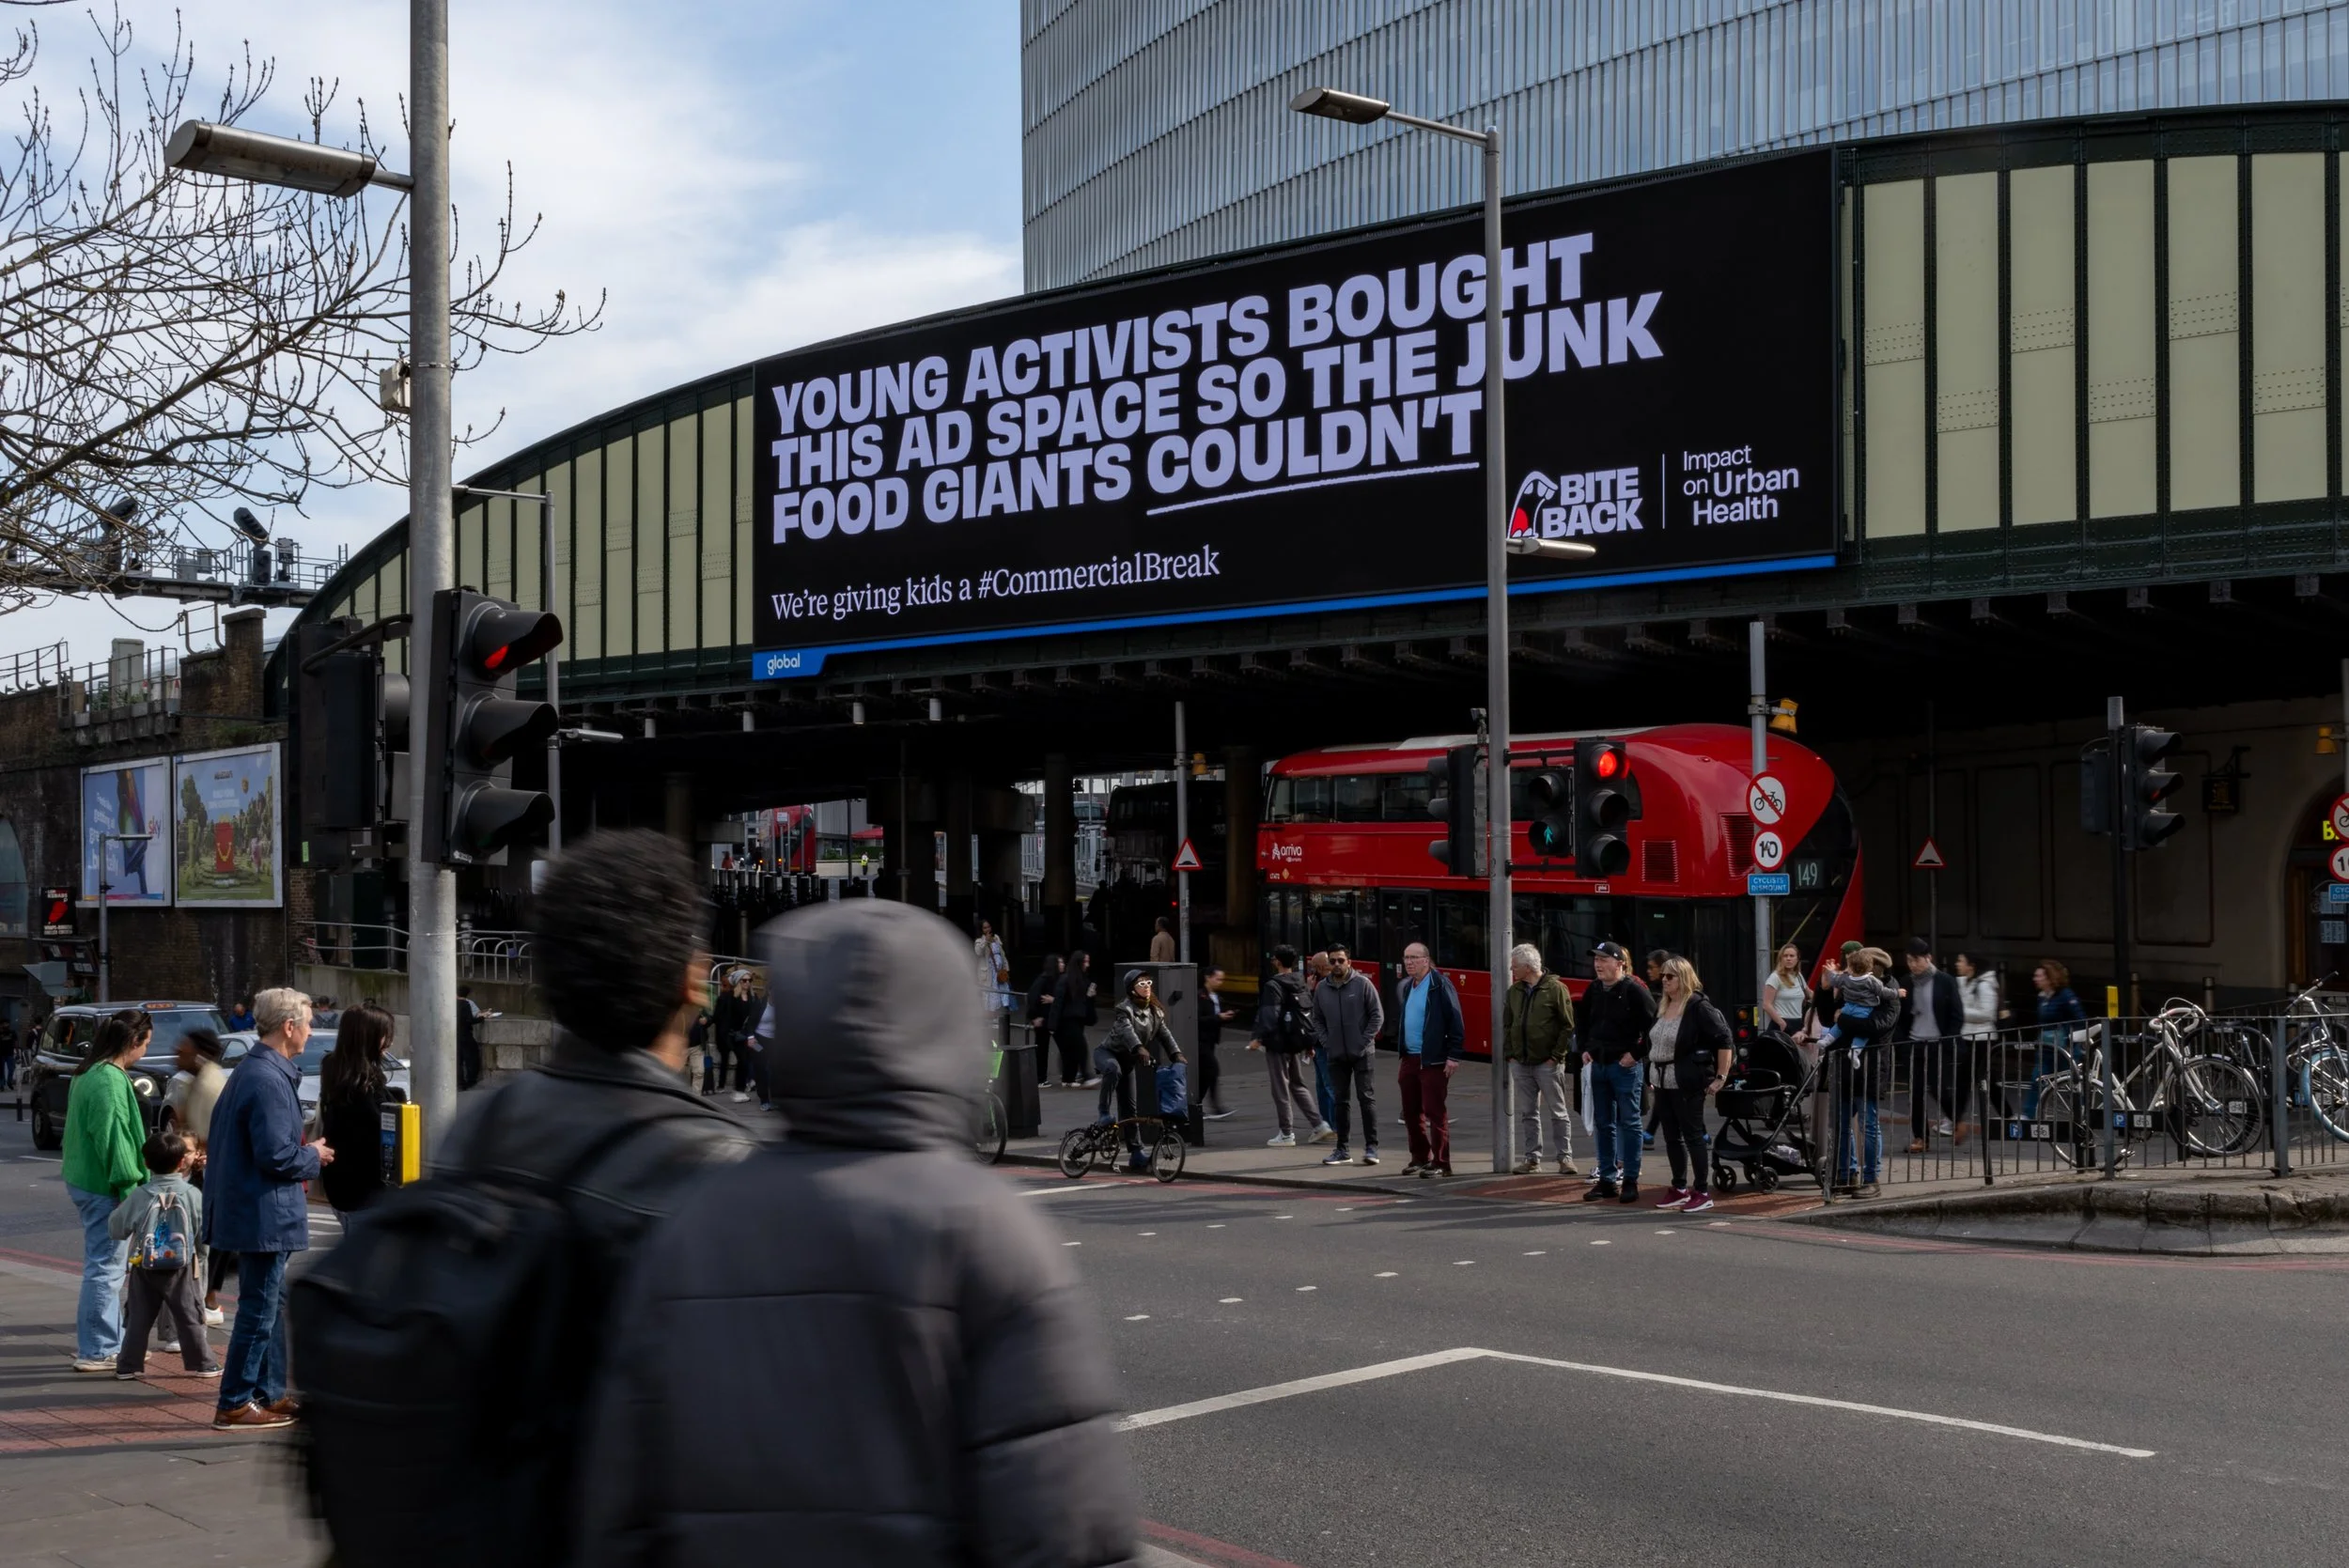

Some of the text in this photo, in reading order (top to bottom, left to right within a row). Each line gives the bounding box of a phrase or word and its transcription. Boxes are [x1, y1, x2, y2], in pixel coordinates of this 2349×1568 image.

[772, 232, 1593, 435] YOUNG ACTIVISTS BOUGHT
[771, 292, 1664, 489] THIS AD SPACE SO THE JUNK
[773, 390, 1483, 544] FOOD GIANTS COULDN'T
[1683, 444, 1752, 474] Impact
[1683, 468, 1799, 497] on Urban
[1542, 467, 1643, 538] BITE BACK
[1693, 494, 1779, 526] Health
[771, 544, 1221, 621] We're giving kids a #CommercialBreak
[767, 652, 801, 675] global
[1281, 844, 1302, 857] arriva
[1759, 841, 1778, 858] 10
[2338, 856, 2349, 872] 1
[1797, 862, 1818, 886] 149
